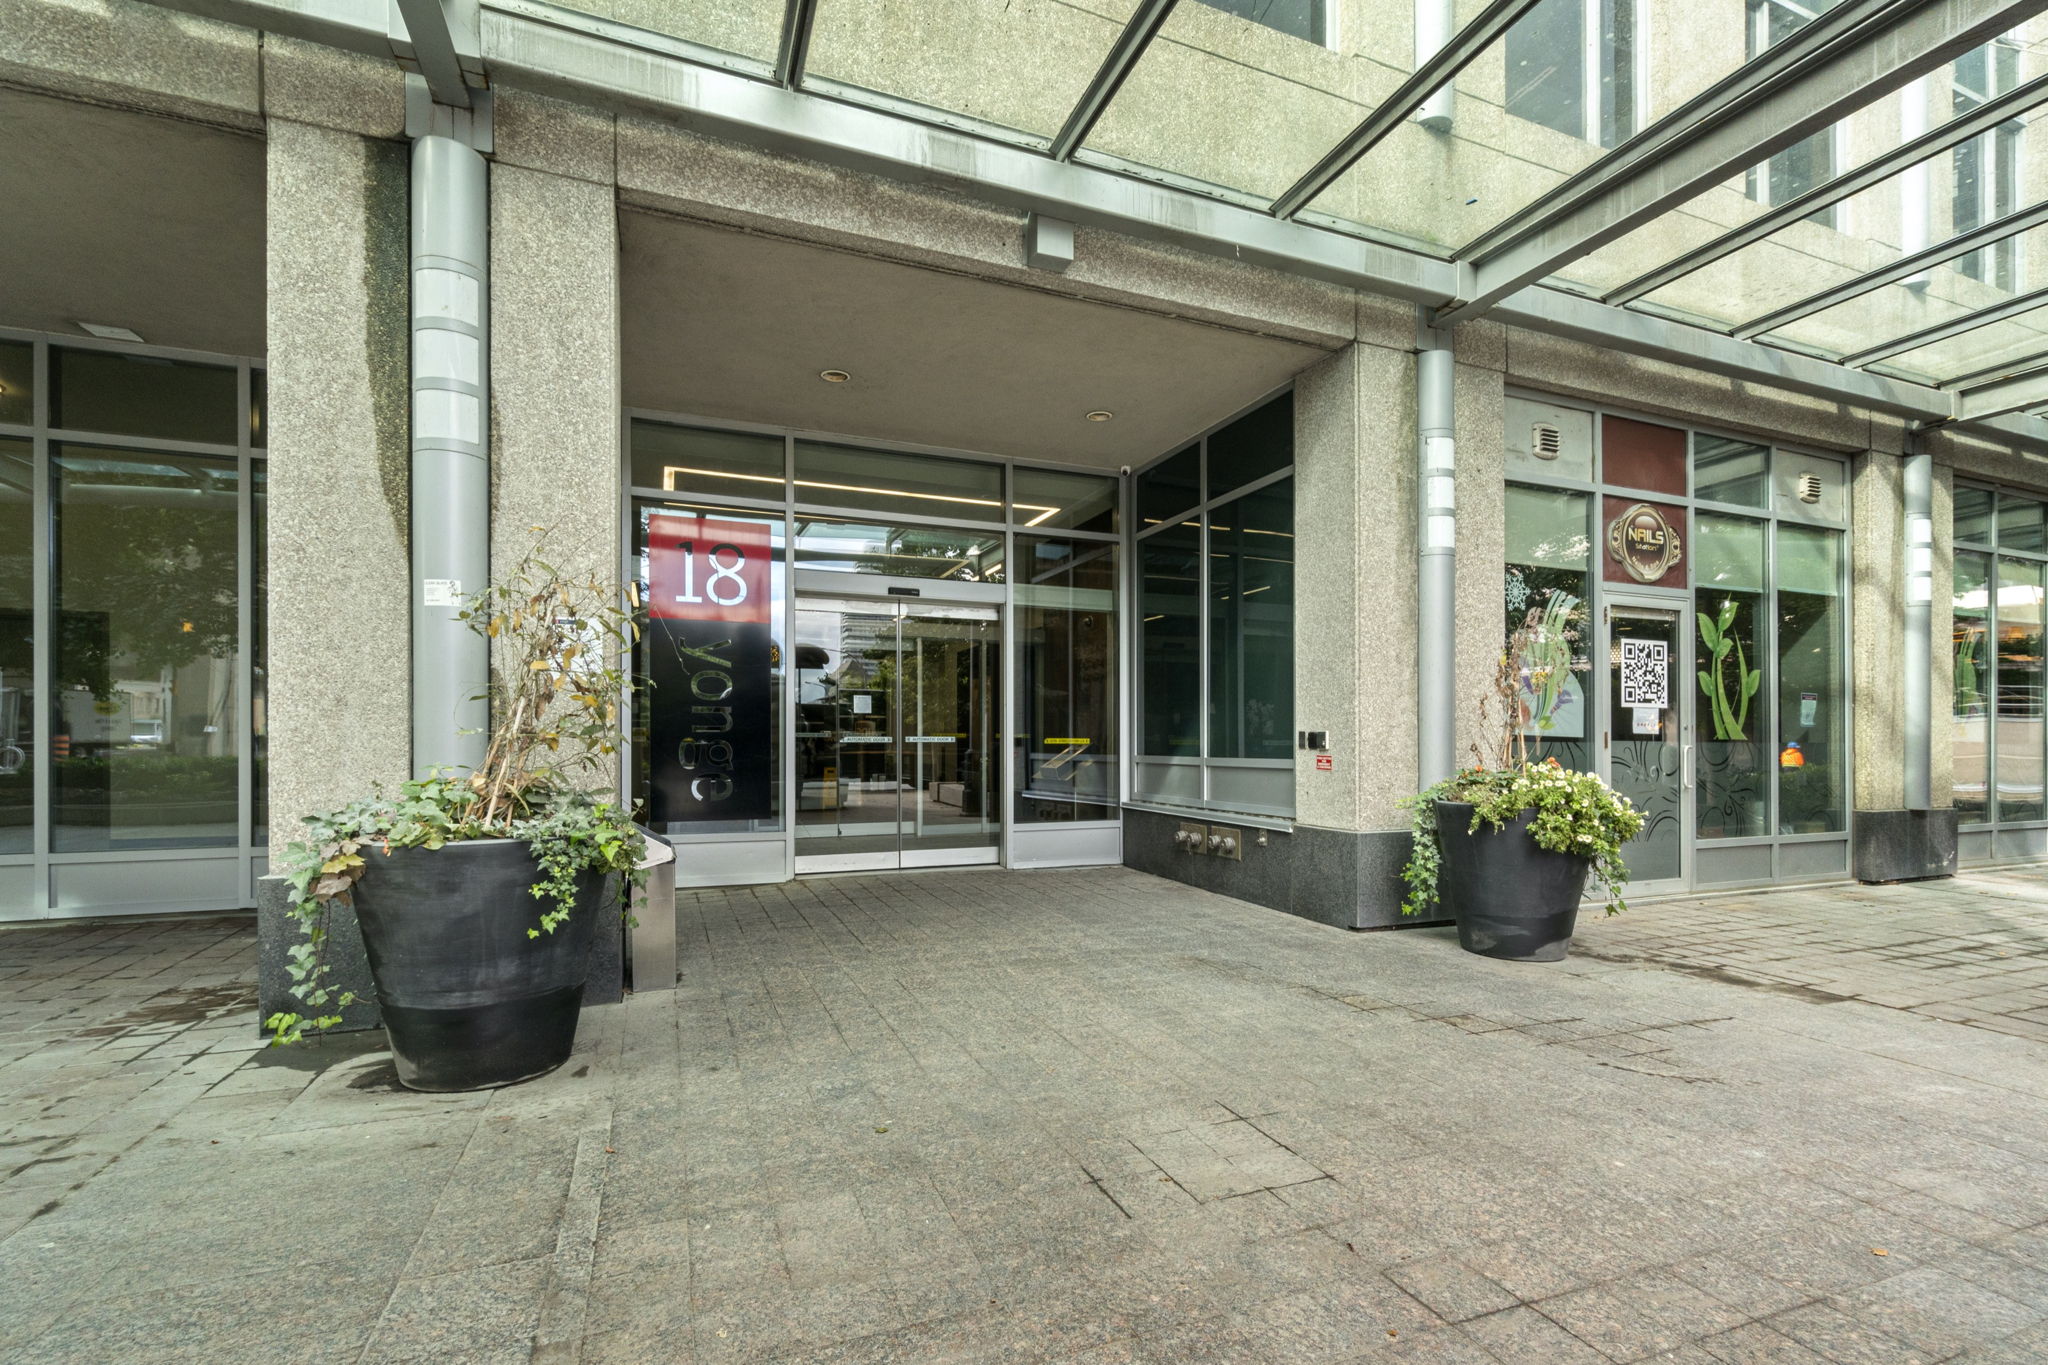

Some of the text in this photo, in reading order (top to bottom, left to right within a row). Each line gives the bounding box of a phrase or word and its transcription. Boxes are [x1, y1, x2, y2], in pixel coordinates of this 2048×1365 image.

[1628, 527, 1664, 544] NAILS
[675, 541, 747, 606] 18
[678, 637, 733, 801] yonge
